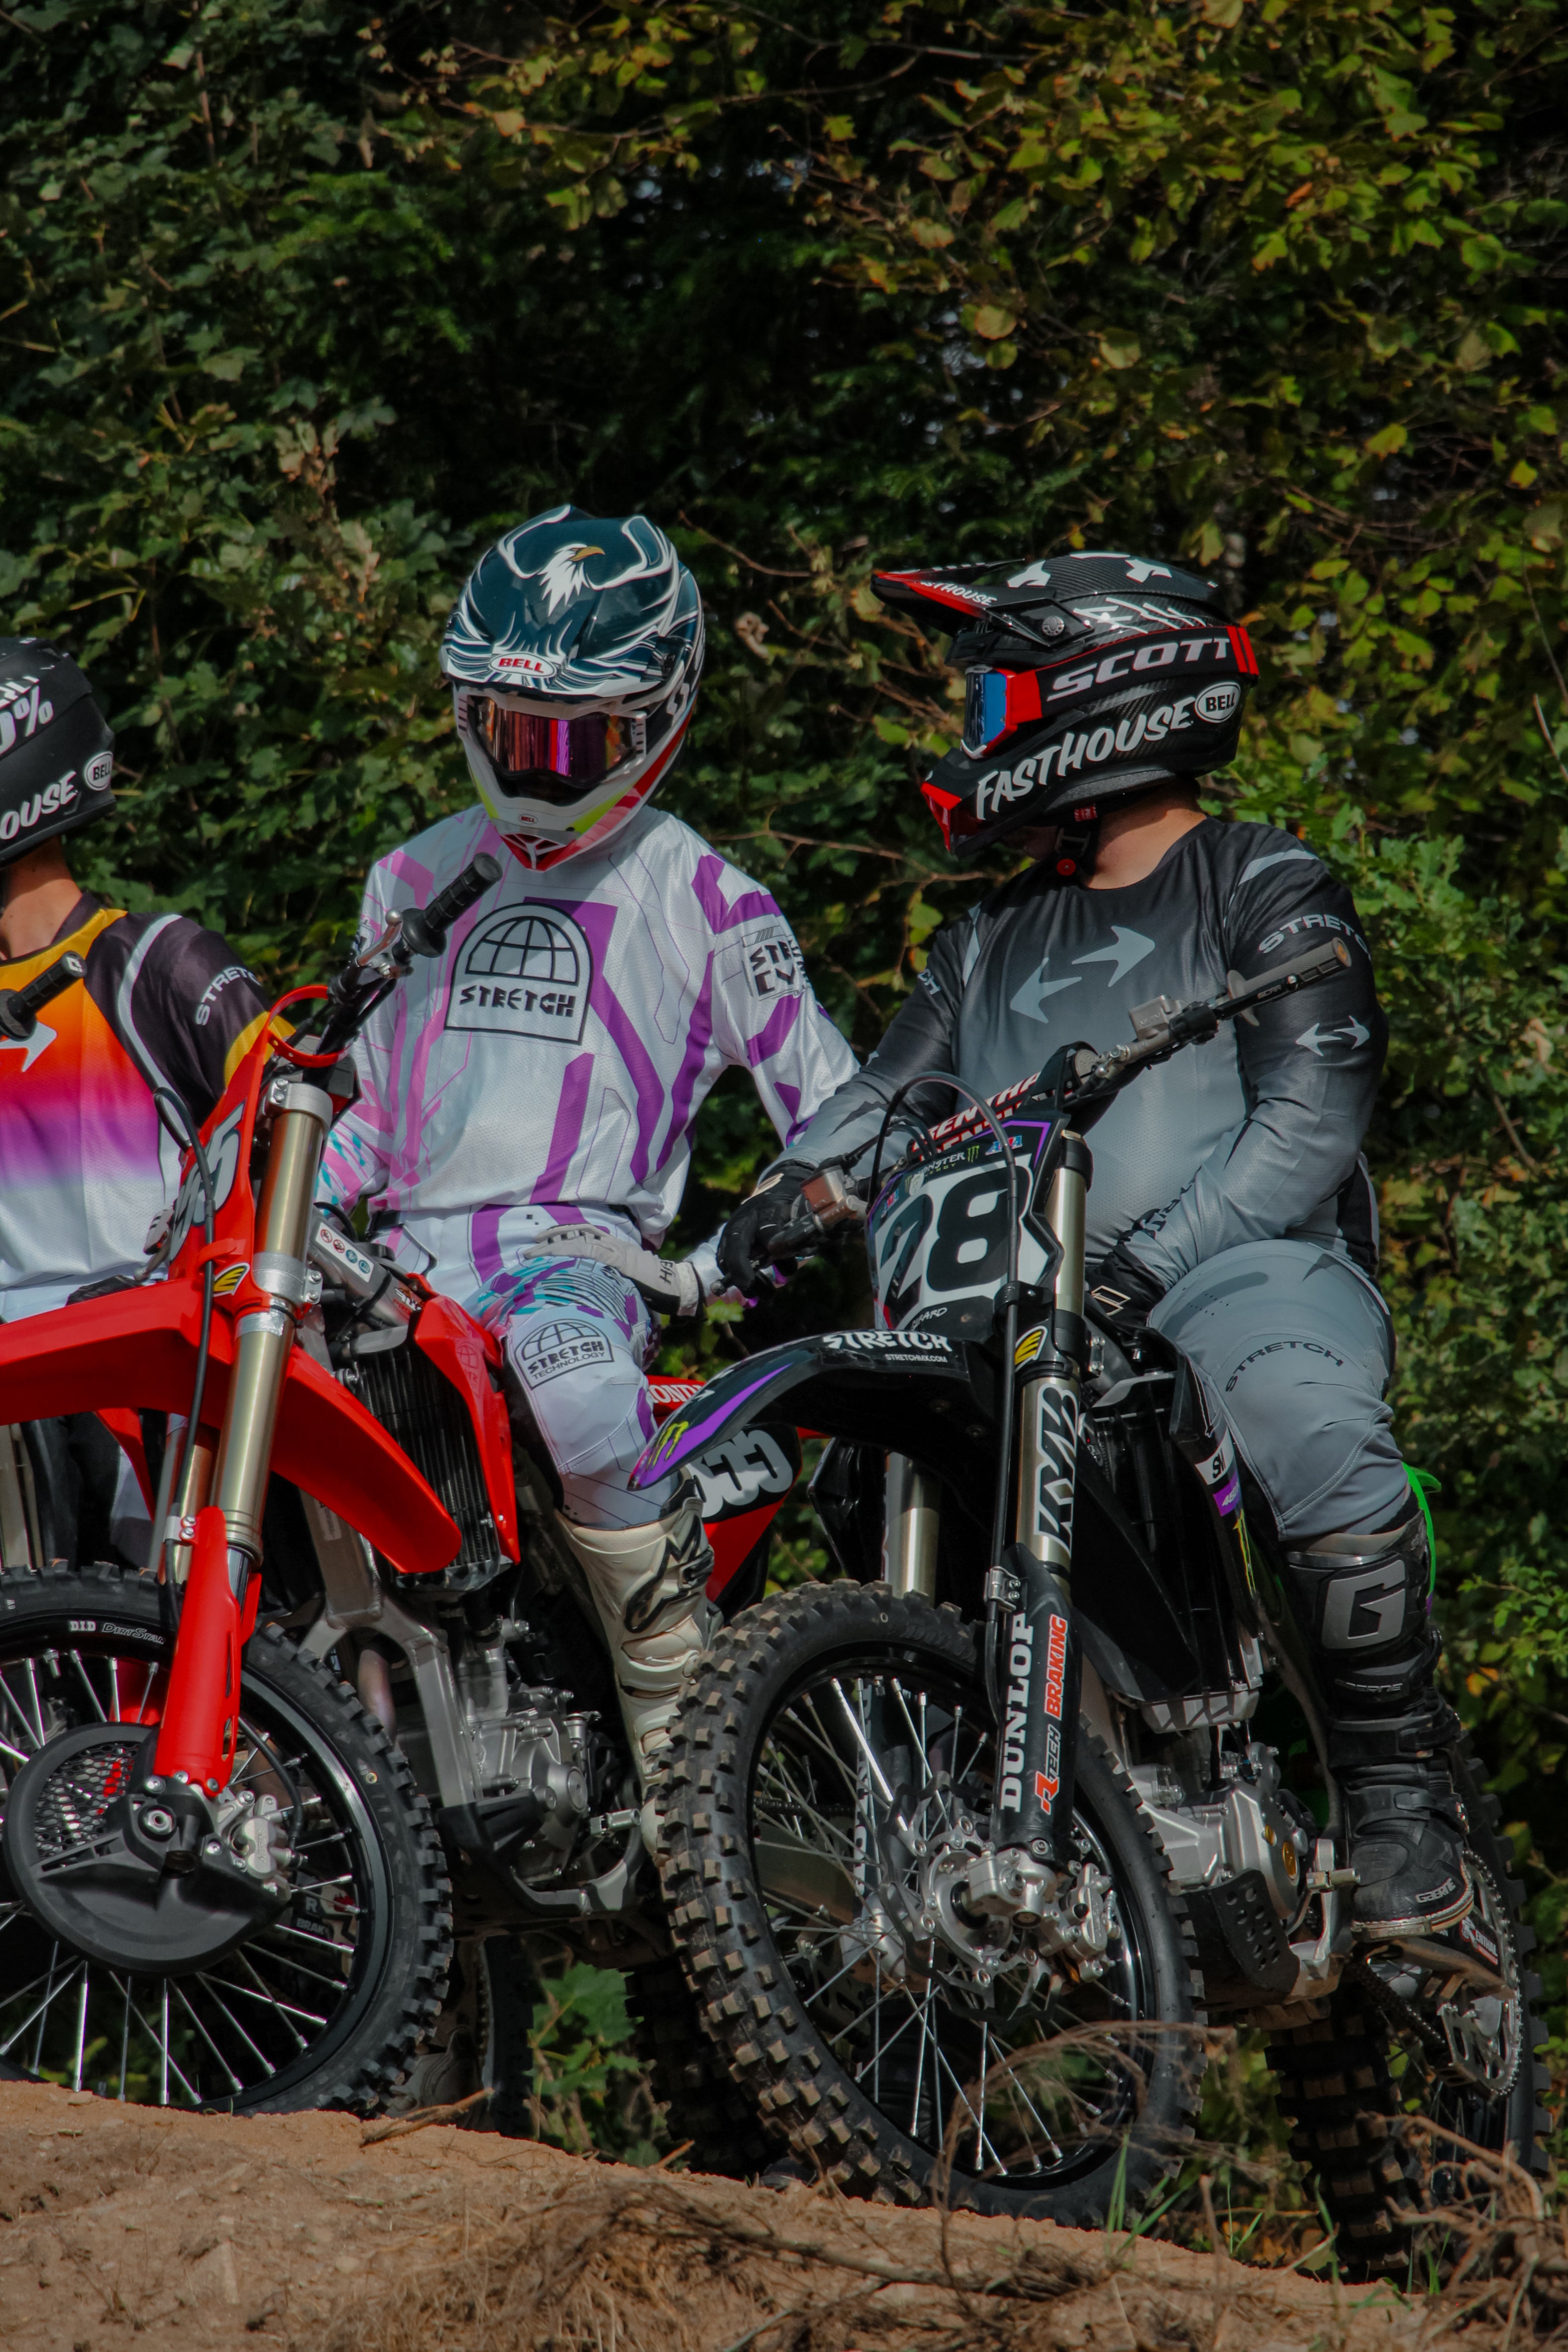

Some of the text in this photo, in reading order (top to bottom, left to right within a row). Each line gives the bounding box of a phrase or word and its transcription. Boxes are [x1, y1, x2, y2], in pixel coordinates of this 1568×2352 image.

[498, 658, 544, 674] BELL
[1047, 637, 1230, 702] SCOTT
[1206, 692, 1235, 712] BELL
[93, 762, 111, 780] BELL
[1257, 914, 1372, 962] STRETC
[459, 984, 577, 1018] STRETCH
[920, 1152, 966, 1175] ONSTER
[880, 1165, 1032, 1328] 28
[528, 1341, 605, 1375] STRETCH
[822, 1331, 953, 1352] STRETCH
[884, 1353, 949, 1363] STRETCHMX.COM
[532, 1351, 605, 1380] TECHNOLOGY
[1225, 1341, 1344, 1392] STRETCH
[1044, 1613, 1069, 1721] BRAKING
[1000, 1611, 1034, 1813] DUNLOP
